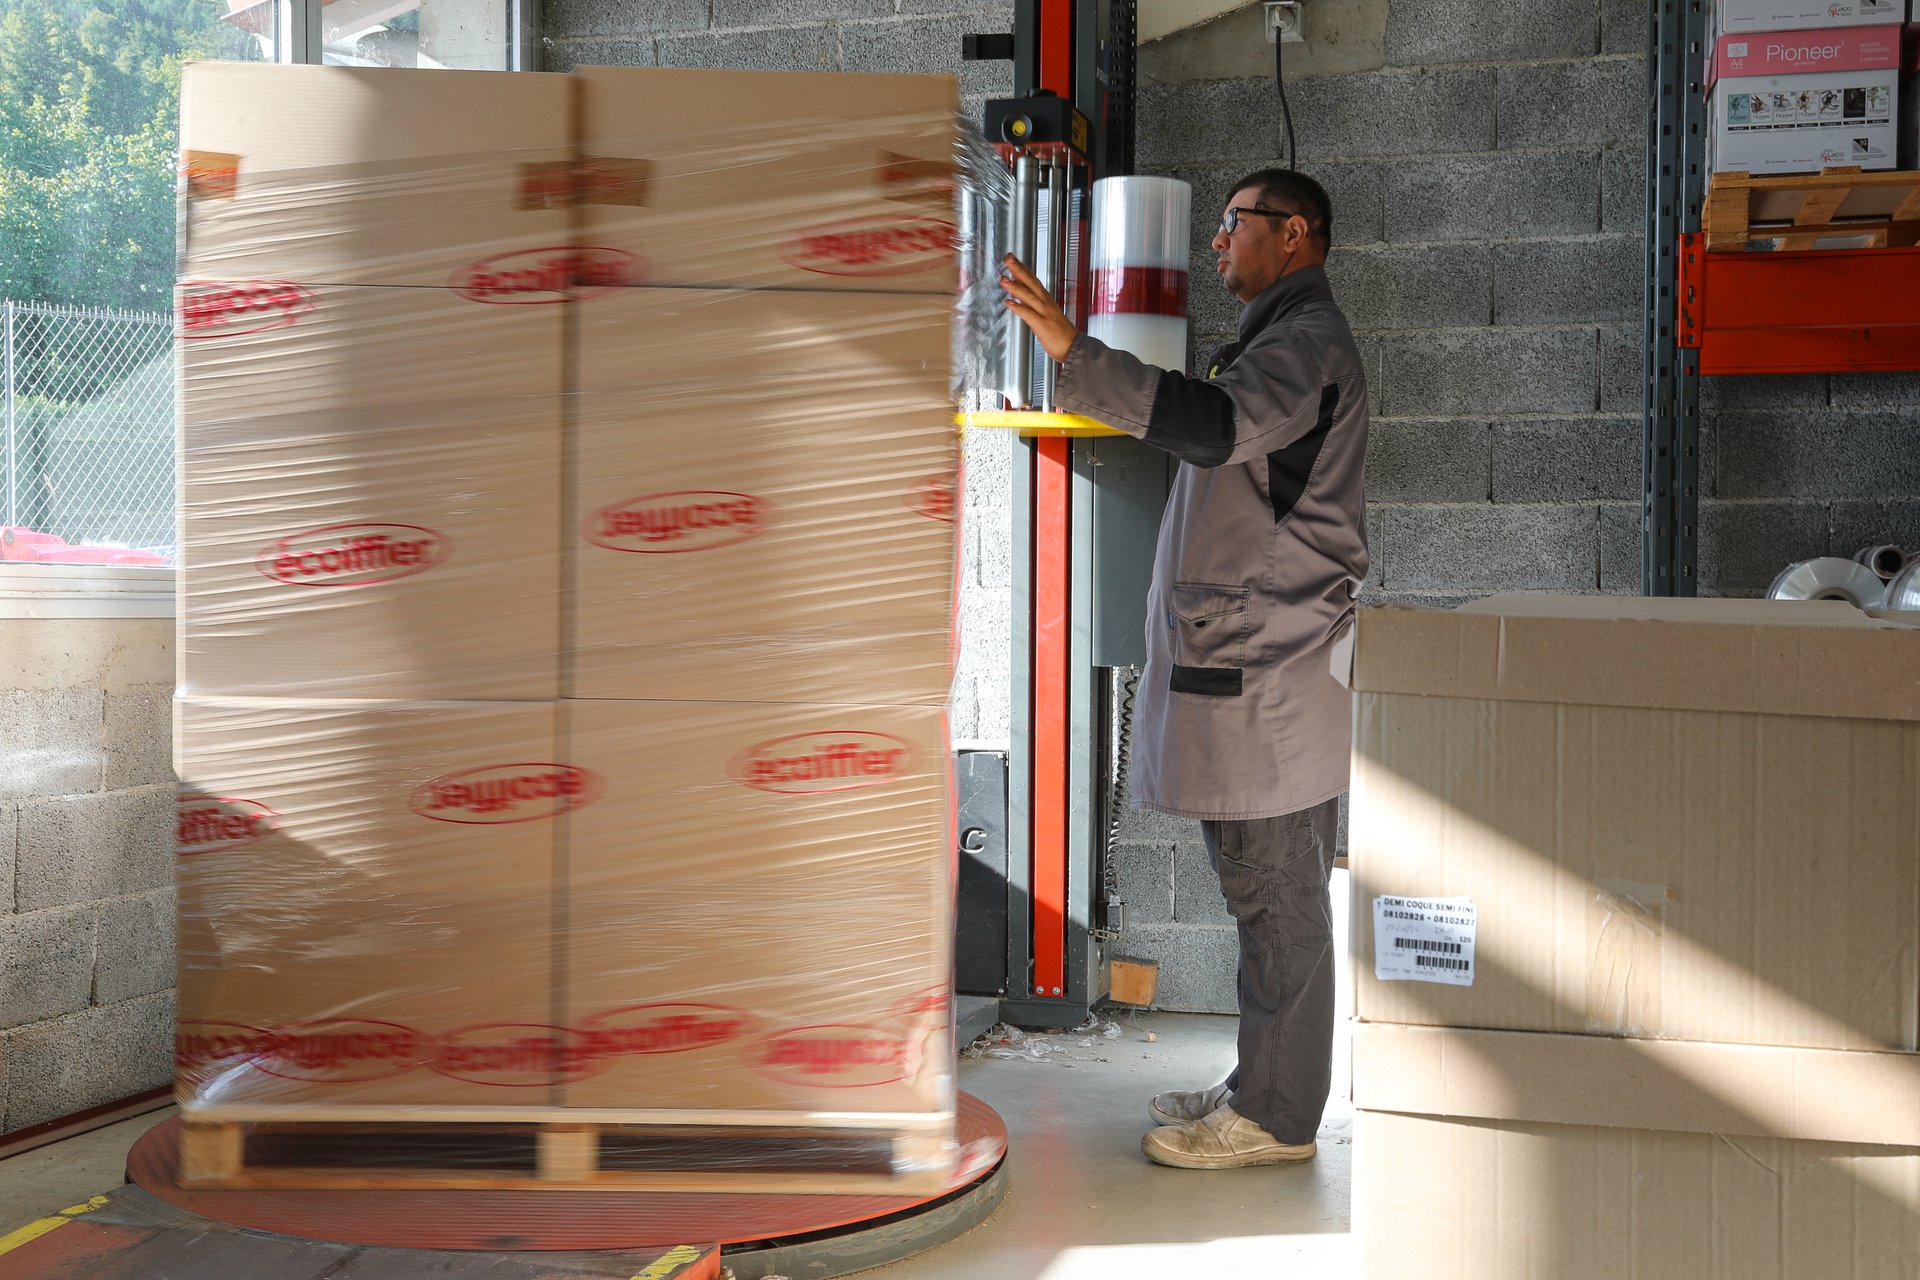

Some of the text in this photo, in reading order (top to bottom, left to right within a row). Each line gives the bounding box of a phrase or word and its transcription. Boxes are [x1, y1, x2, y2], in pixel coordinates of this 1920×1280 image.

[1766, 44, 1842, 62] Pioneer
[1384, 898, 1404, 907] DEMI
[1406, 900, 1433, 909] COQUE
